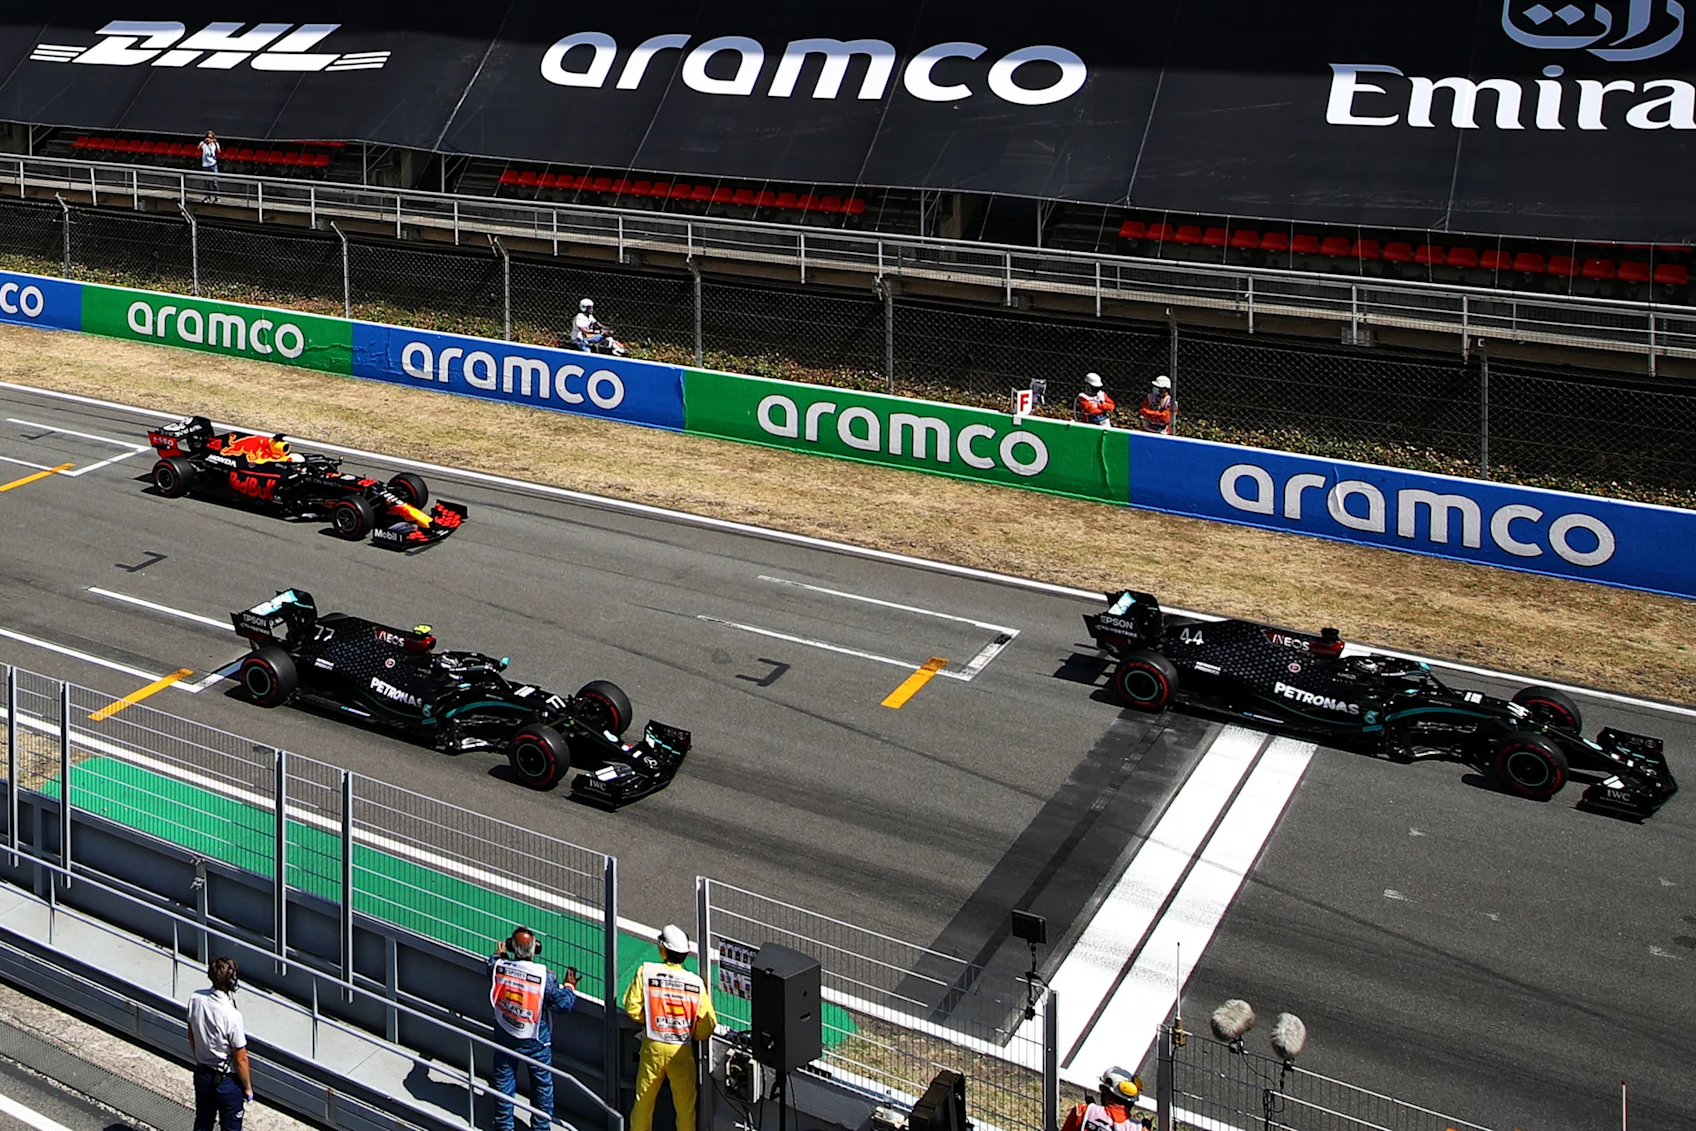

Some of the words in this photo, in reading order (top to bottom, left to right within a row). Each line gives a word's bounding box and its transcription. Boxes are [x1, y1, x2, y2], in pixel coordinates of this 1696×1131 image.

[72, 20, 344, 72] DHL
[540, 31, 1088, 110] aramco
[126, 297, 307, 360] aramco
[400, 336, 624, 410] aramco
[1020, 393, 1030, 412] F
[754, 390, 1050, 480] aramco
[208, 454, 237, 468] HONDA
[1216, 462, 1618, 568] aramco
[374, 527, 398, 542] Mobil
[242, 613, 267, 628] EPSON
[1100, 615, 1135, 630] EPSON
[314, 624, 336, 642] 77
[1180, 627, 1205, 646] 44
[1272, 633, 1311, 652] INEOS
[370, 676, 424, 709] PETRONAS
[1273, 681, 1362, 716] PETRONAS
[589, 779, 608, 792] IWC
[1606, 788, 1632, 802] IWC
